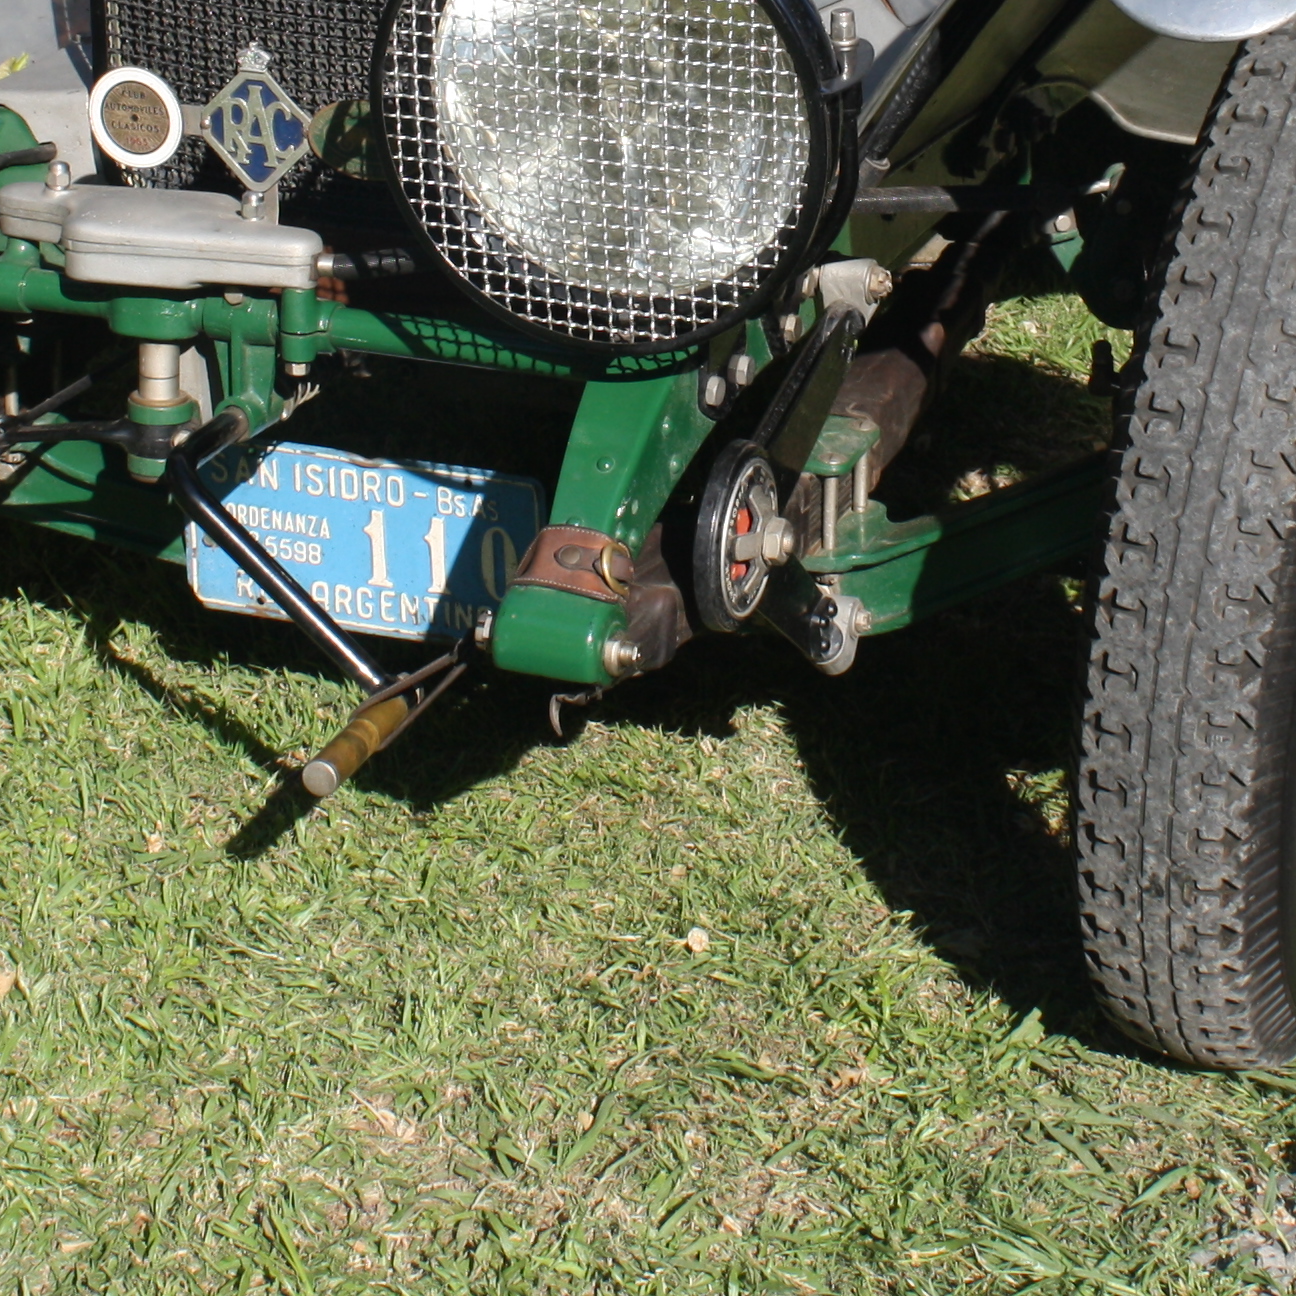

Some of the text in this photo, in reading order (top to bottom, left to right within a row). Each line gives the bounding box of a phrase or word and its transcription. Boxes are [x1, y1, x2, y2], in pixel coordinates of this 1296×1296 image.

[104, 102, 165, 116] AUTOMOVILES
[111, 119, 161, 134] CLASICOS
[218, 84, 296, 168] RAC
[210, 452, 279, 491] SAN
[293, 463, 405, 508] ISIDRO
